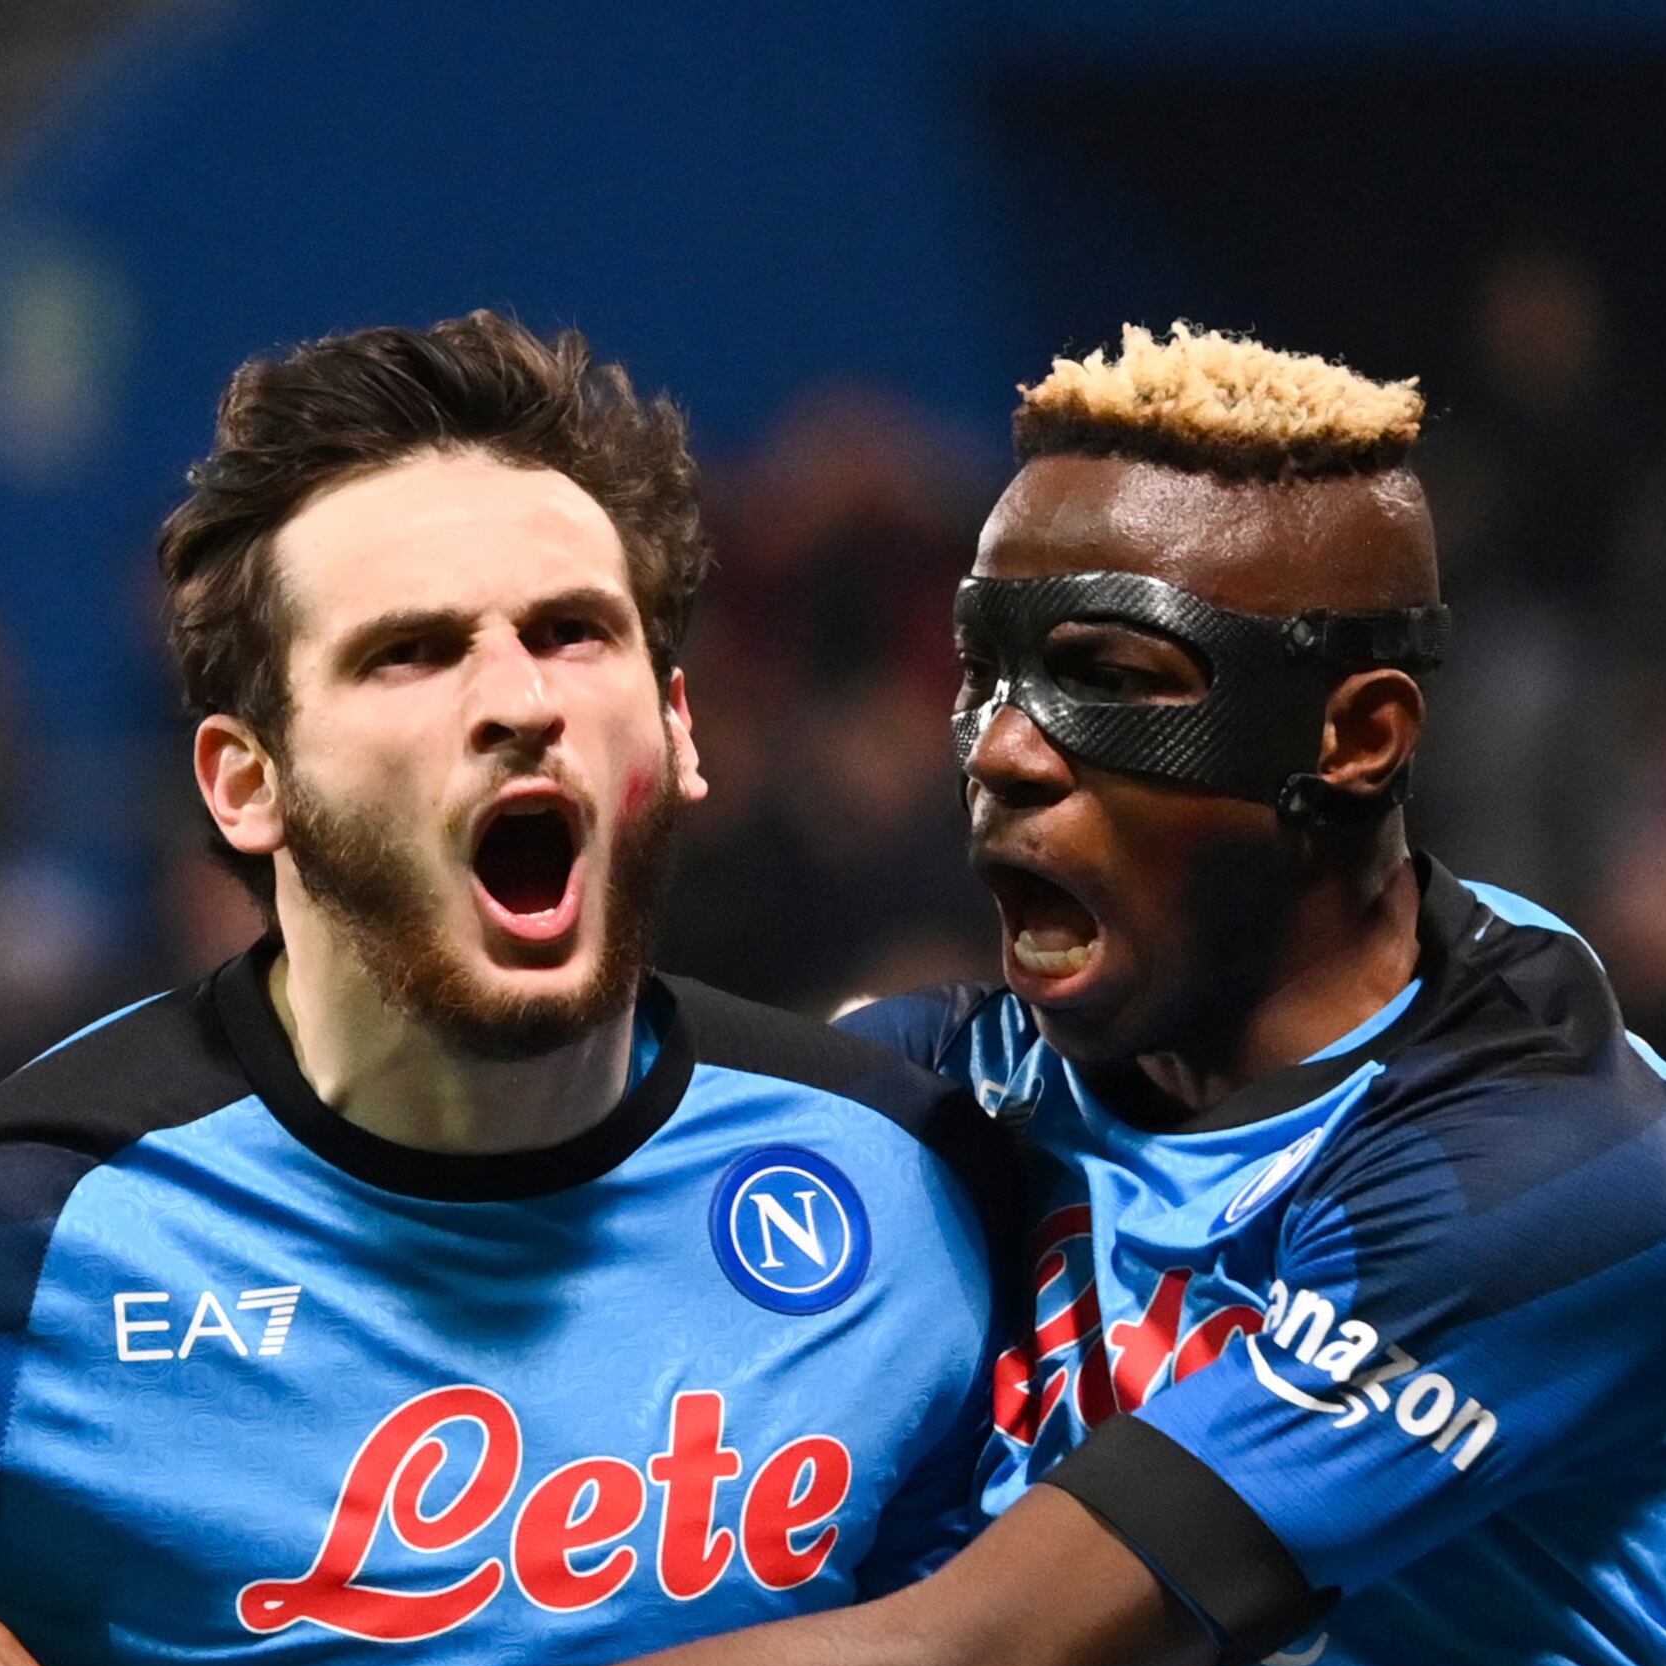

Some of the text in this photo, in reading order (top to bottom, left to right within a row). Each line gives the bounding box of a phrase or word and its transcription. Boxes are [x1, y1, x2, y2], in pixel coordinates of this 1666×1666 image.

[748, 1189, 824, 1270] N
[114, 1284, 302, 1362] EA7
[236, 1383, 852, 1642] Lete
